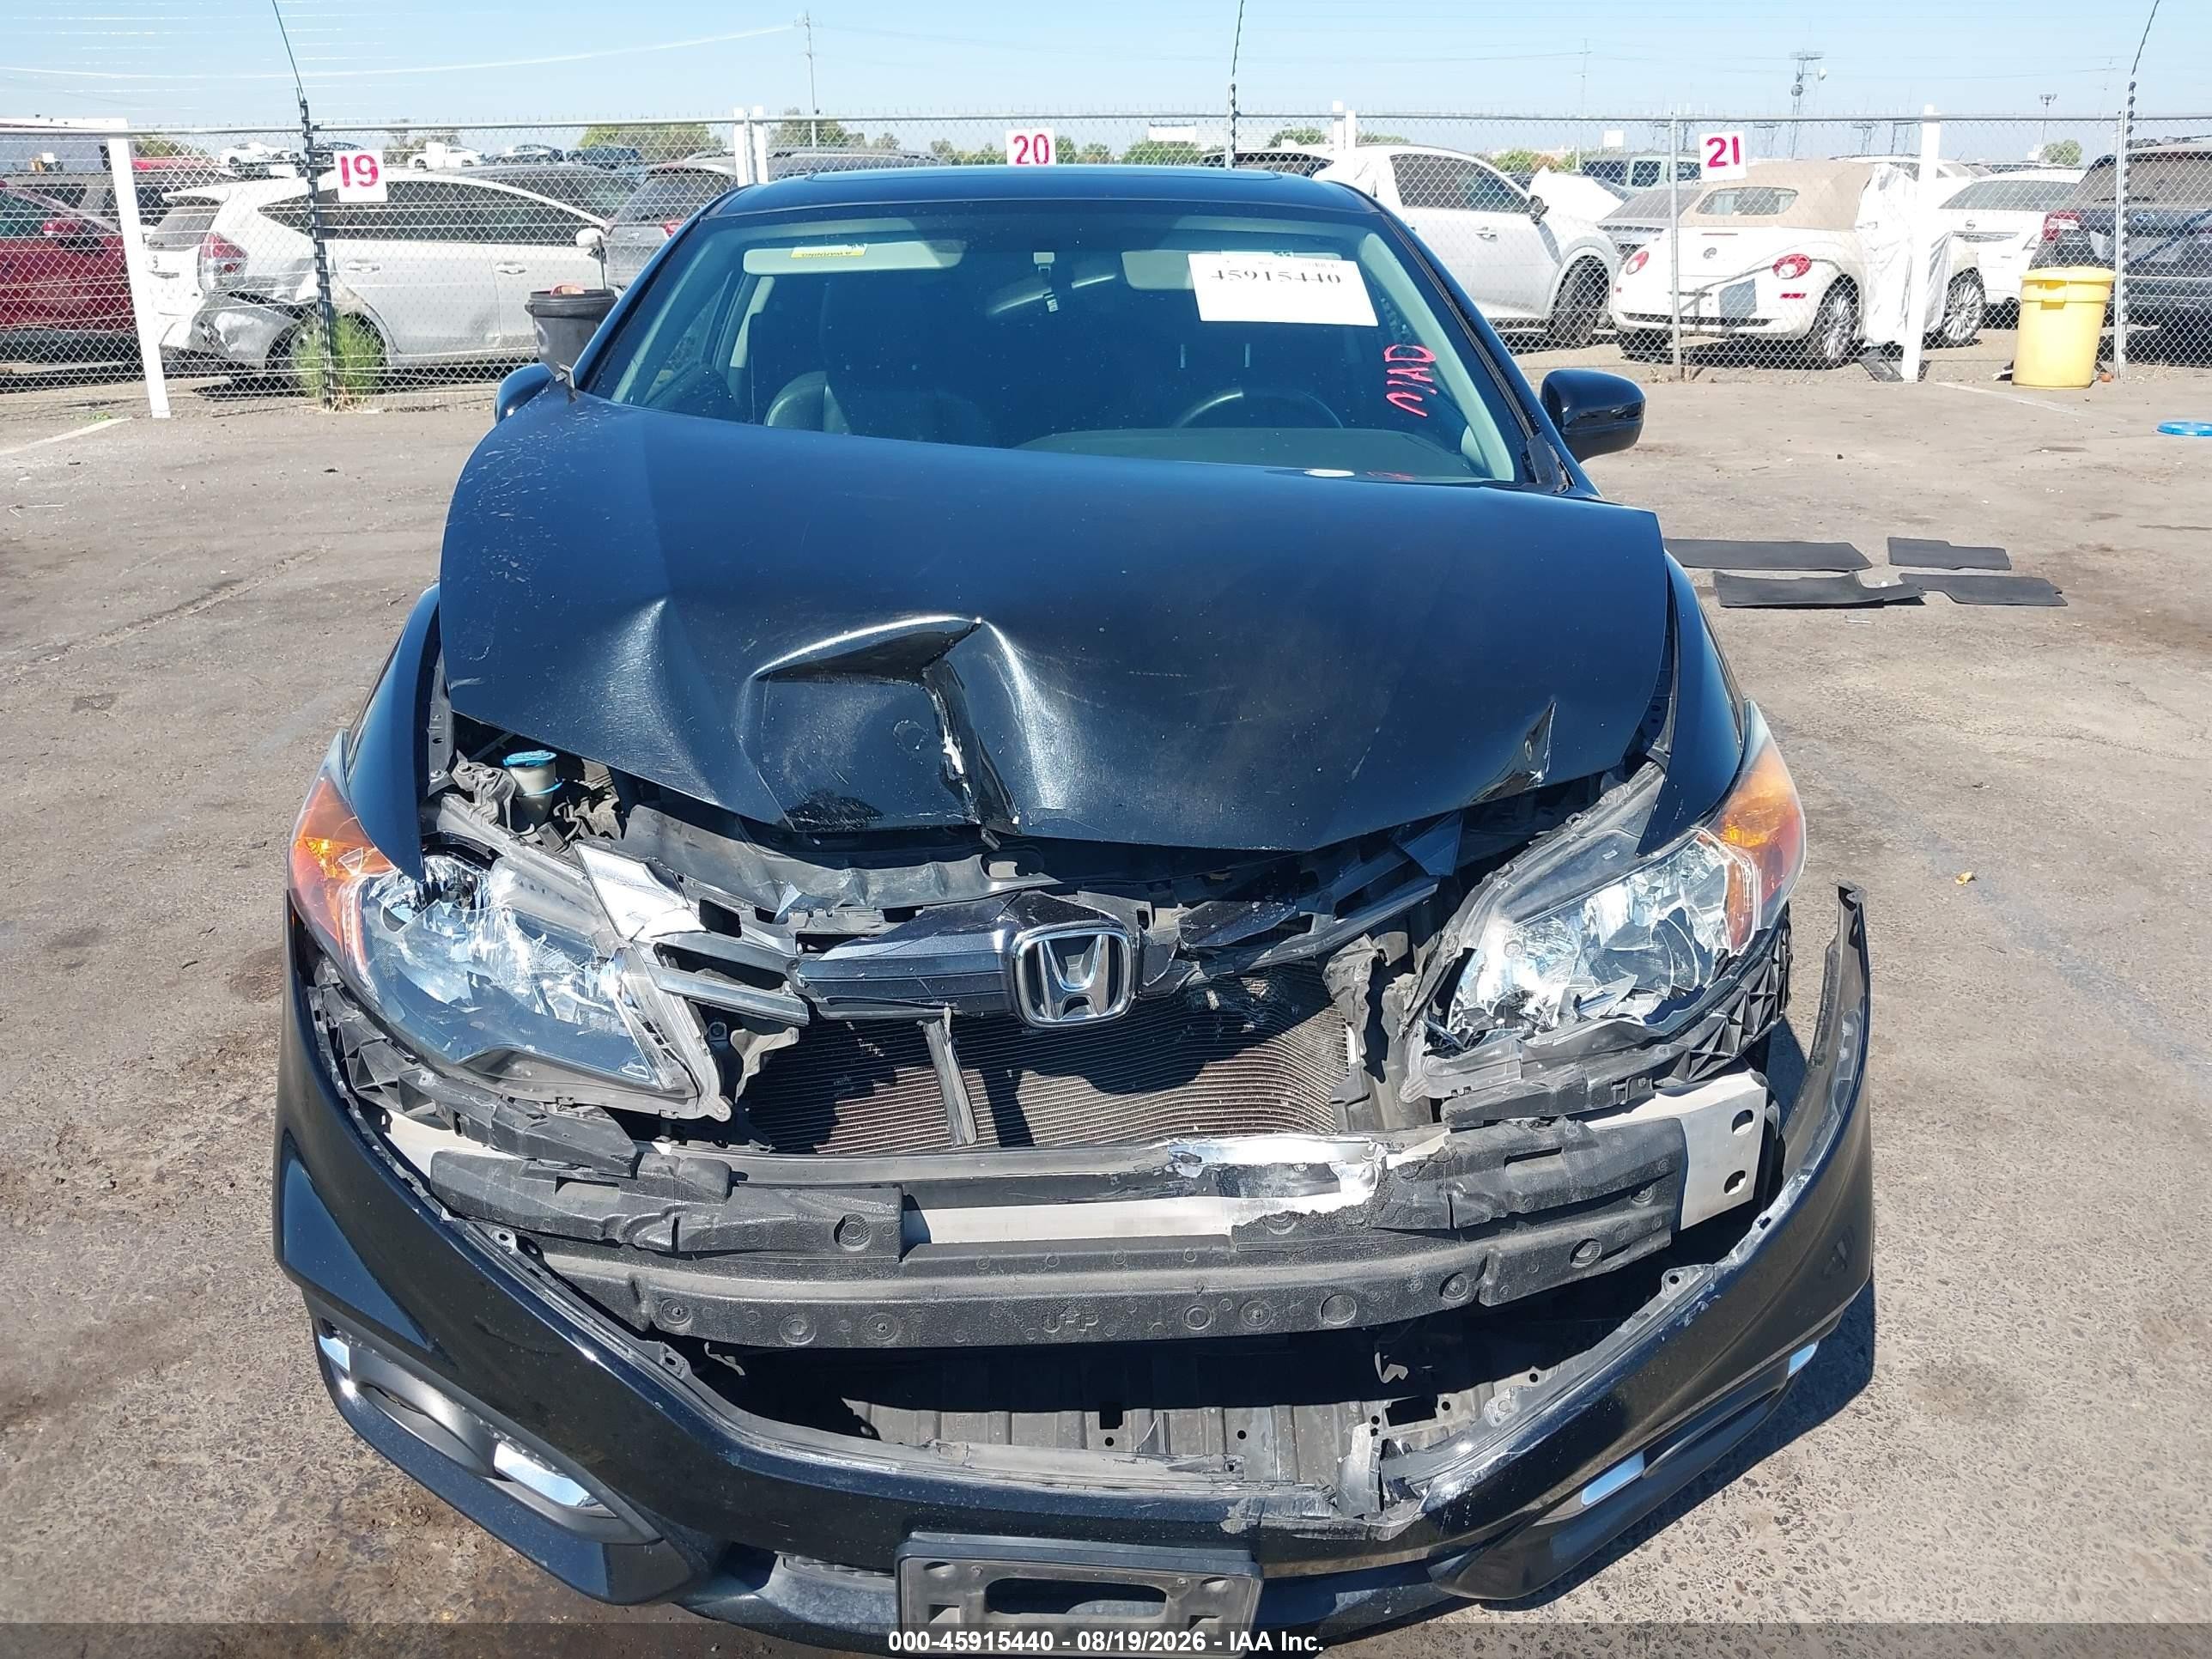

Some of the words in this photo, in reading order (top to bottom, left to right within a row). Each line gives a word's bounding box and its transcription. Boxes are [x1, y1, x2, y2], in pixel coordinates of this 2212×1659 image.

[1013, 133, 1049, 164] 20
[1706, 136, 1740, 167] 21
[340, 155, 379, 187] 19
[1210, 269, 1341, 285] 45915440
